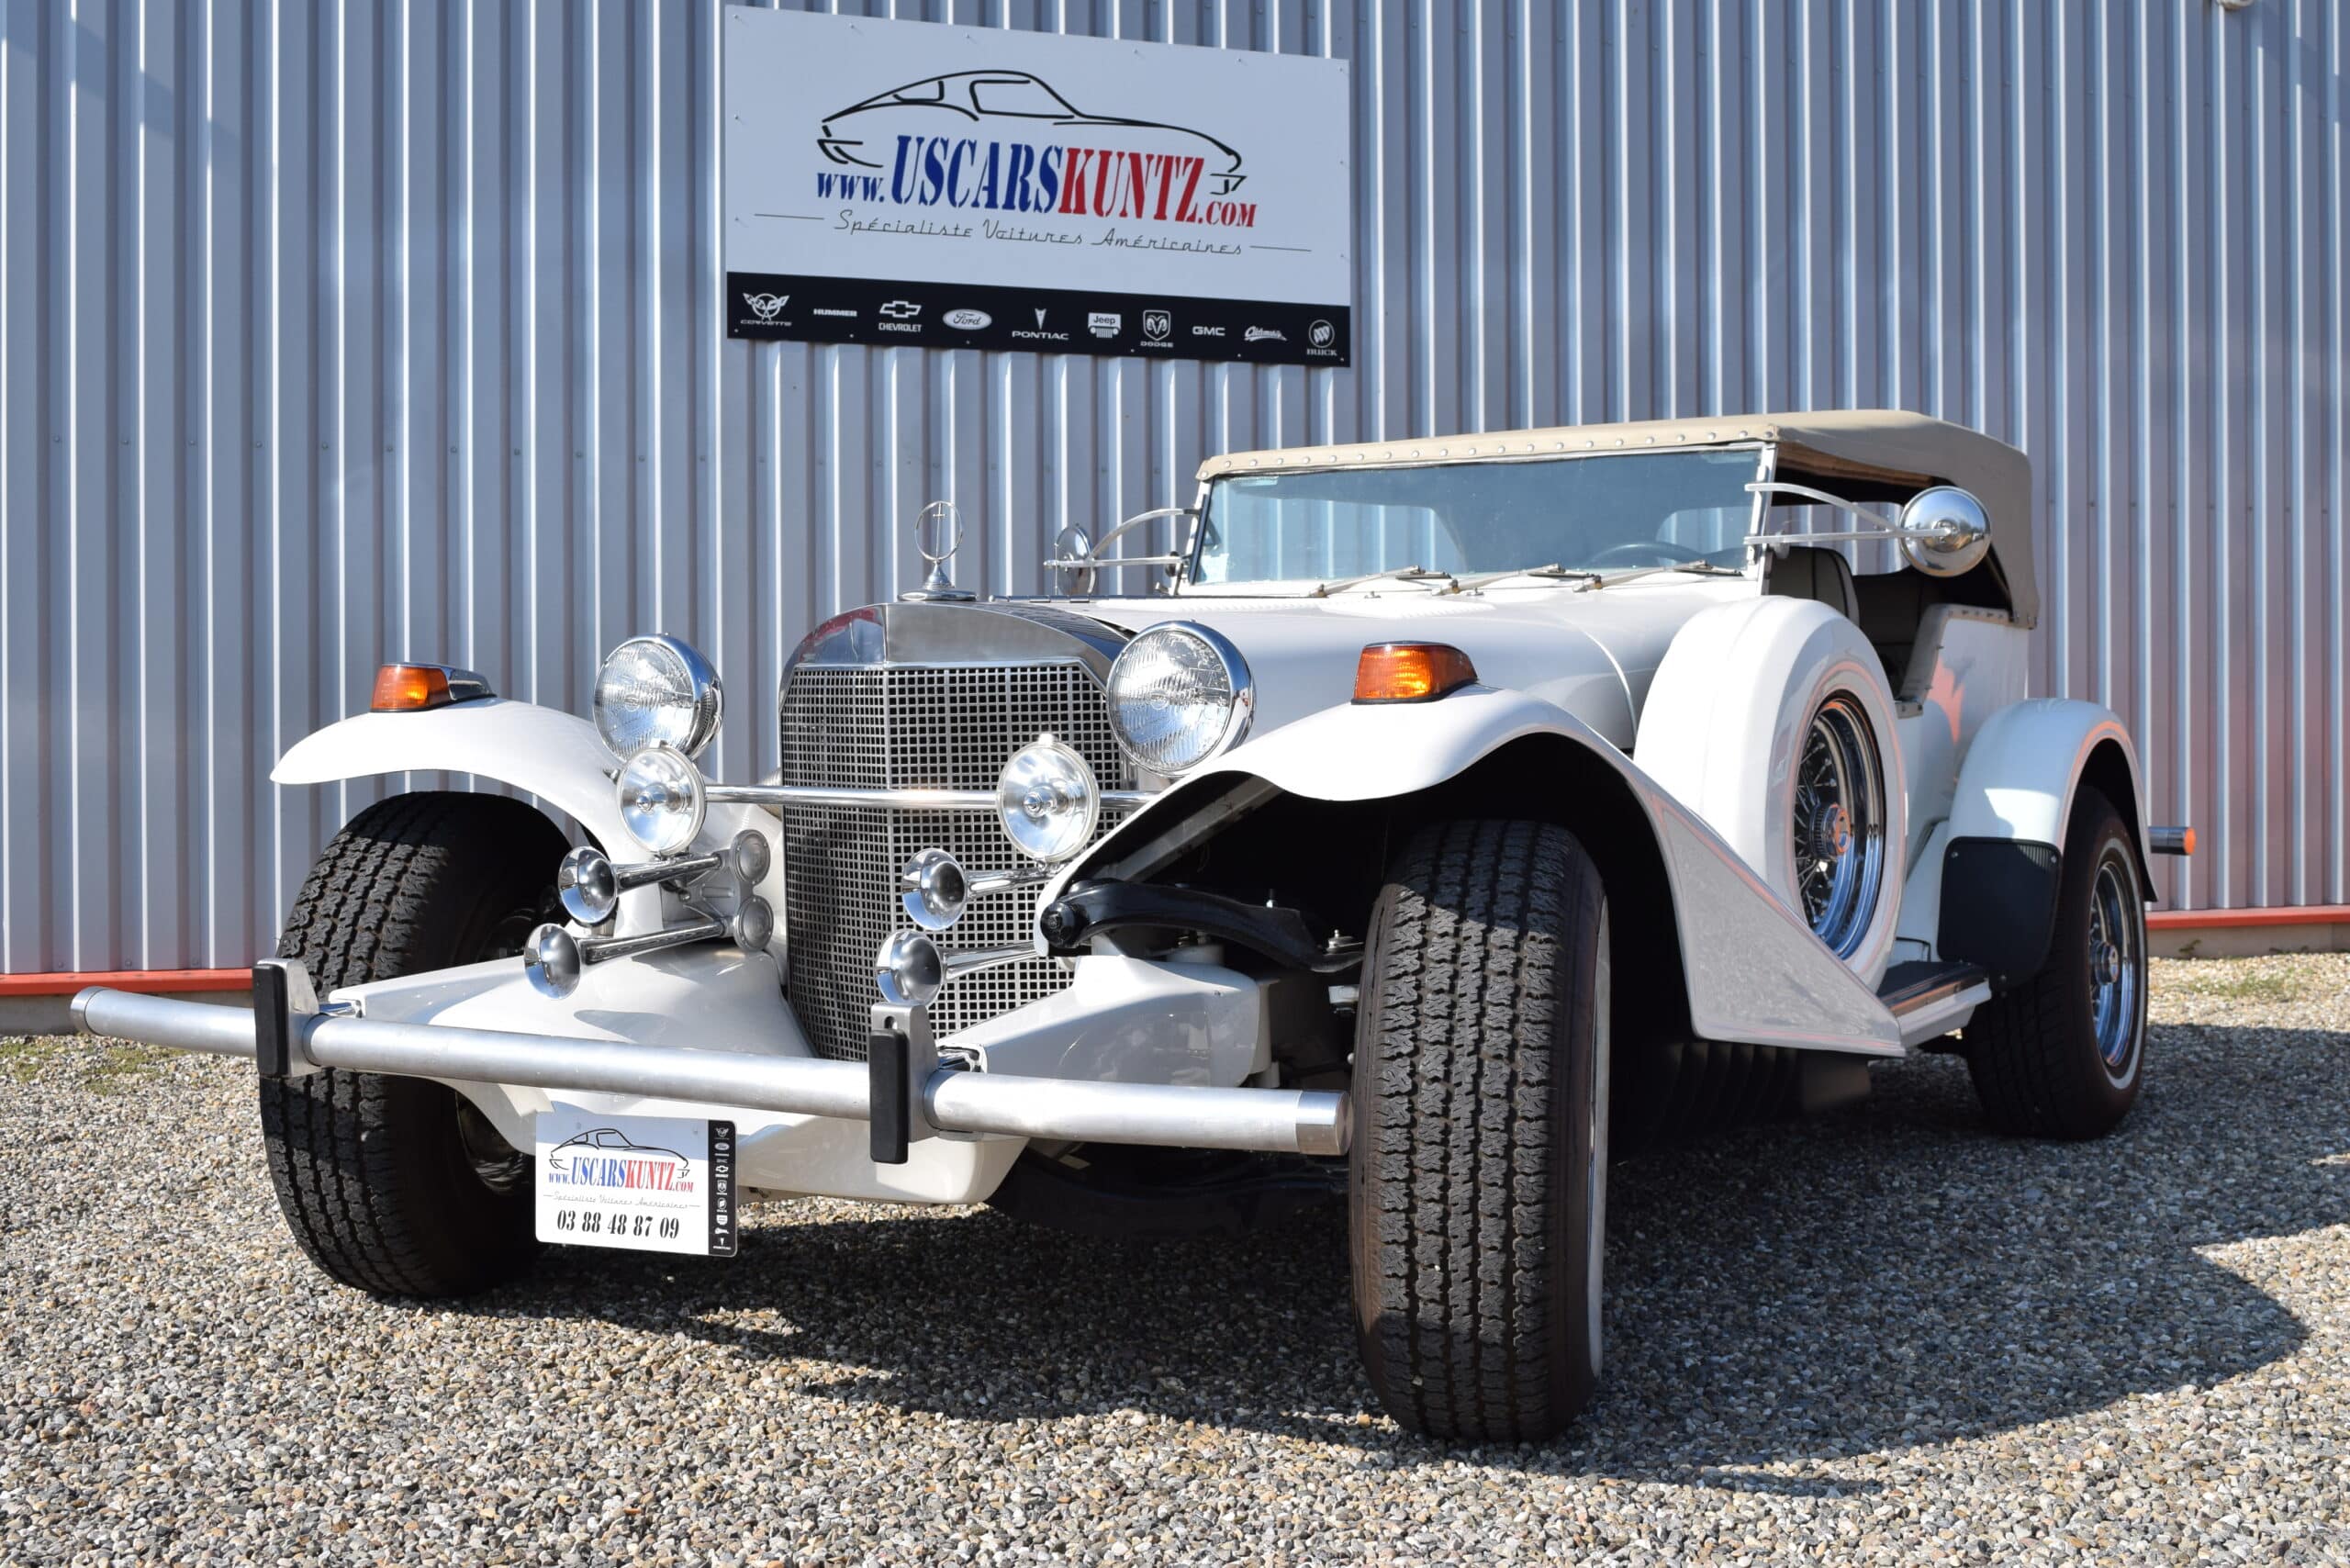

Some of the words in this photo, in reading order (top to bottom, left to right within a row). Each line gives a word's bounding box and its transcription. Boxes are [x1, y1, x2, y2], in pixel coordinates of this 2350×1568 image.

[833, 208, 973, 239] Spécialiste
[982, 218, 1083, 245] Voitures
[1091, 229, 1243, 255] Américaines
[813, 308, 858, 317] HUMMER
[952, 311, 983, 326] Ford
[1092, 314, 1116, 325] Jeep
[878, 322, 923, 333] CHEVROLET
[1192, 326, 1226, 337] GMC
[1012, 330, 1069, 342] PONTIAC
[1140, 341, 1174, 349] DODGE
[1306, 348, 1338, 357] BUICK
[556, 1209, 576, 1231] 03
[581, 1212, 601, 1233] 88
[607, 1214, 628, 1236] 48
[632, 1215, 654, 1238] 87
[659, 1217, 680, 1239] 09
